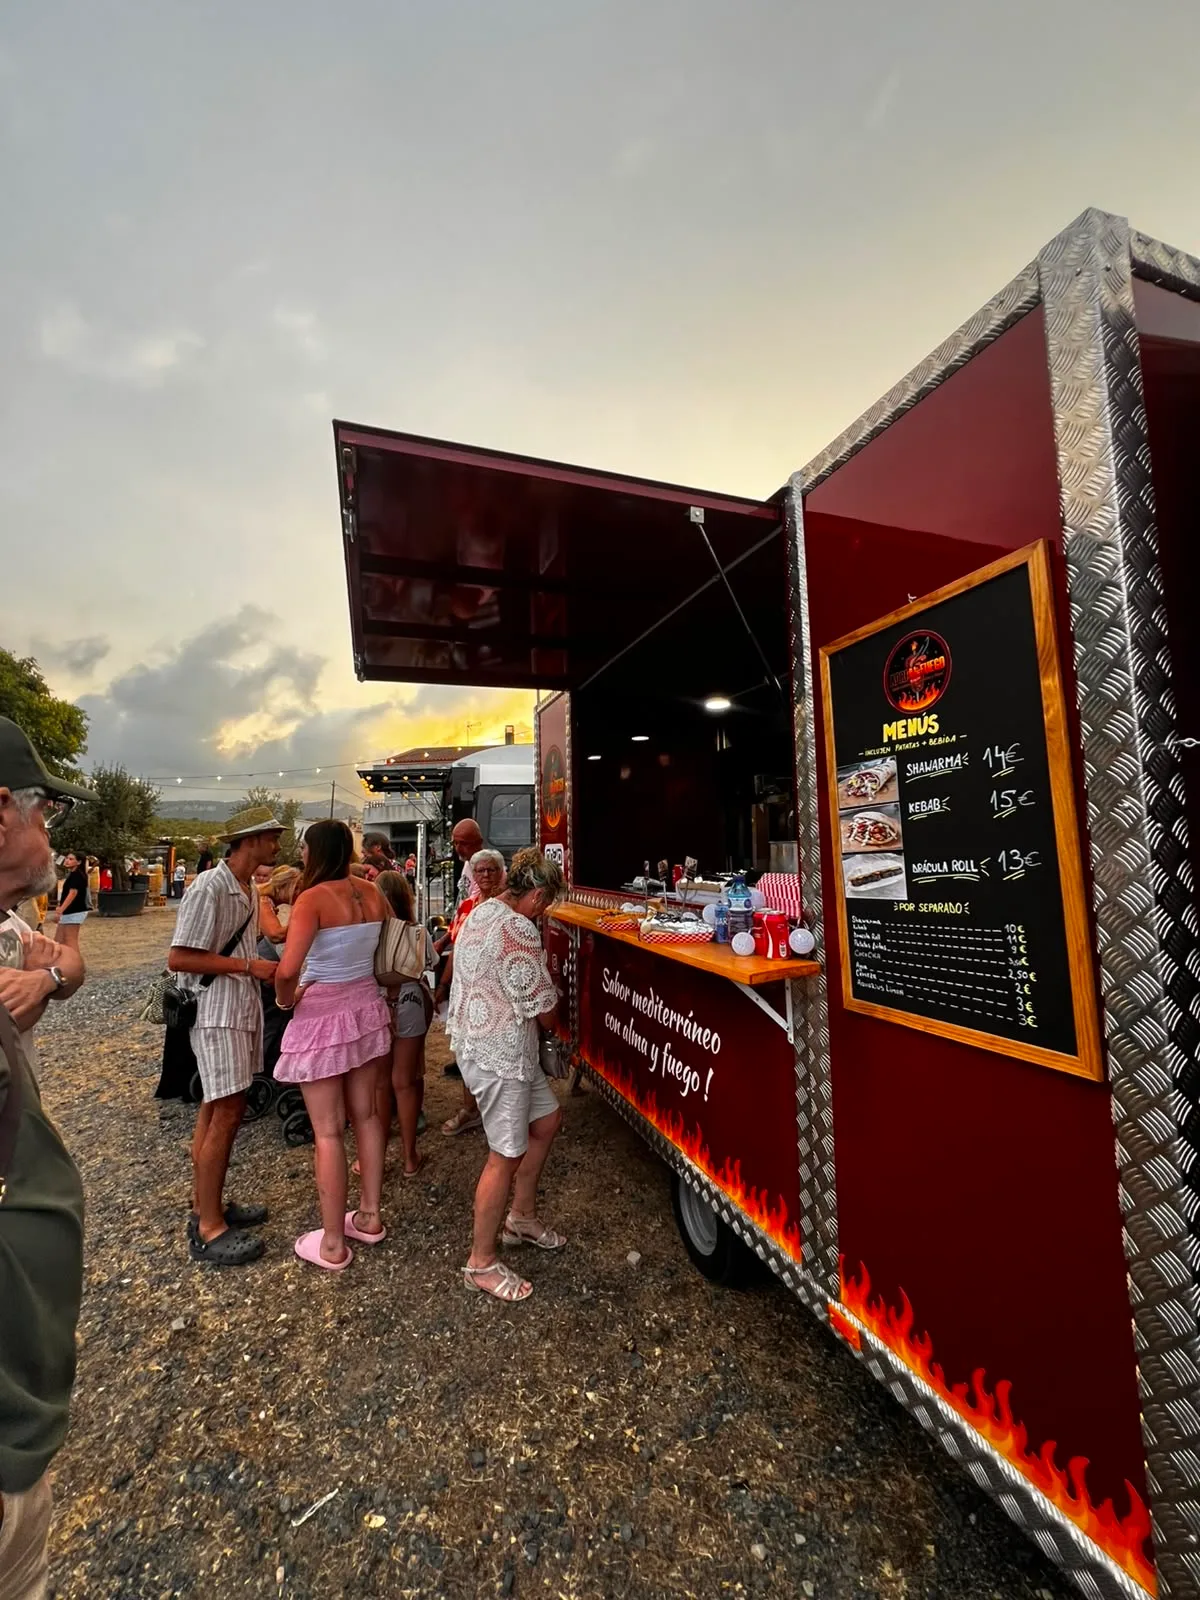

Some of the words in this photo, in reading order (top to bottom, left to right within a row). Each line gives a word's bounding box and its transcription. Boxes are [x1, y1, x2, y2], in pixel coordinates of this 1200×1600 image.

[883, 712, 940, 743] MENÚS
[895, 741, 920, 752] PATATAS
[906, 753, 962, 777] SHAWARMA
[982, 742, 1025, 769] 14€
[908, 798, 941, 814] KEBAB
[990, 789, 1036, 811] 15€
[912, 859, 949, 874] DRÁCULA
[951, 859, 979, 873] ROLL
[998, 849, 1042, 872] 13€
[899, 902, 915, 912] POR
[918, 902, 963, 914] SEPARADO
[602, 967, 631, 1003] Sabor
[632, 987, 721, 1055] mediterráneo
[605, 1012, 621, 1035] con
[622, 1017, 648, 1056] alma
[648, 1043, 659, 1072] y
[662, 1042, 700, 1097] fuego
